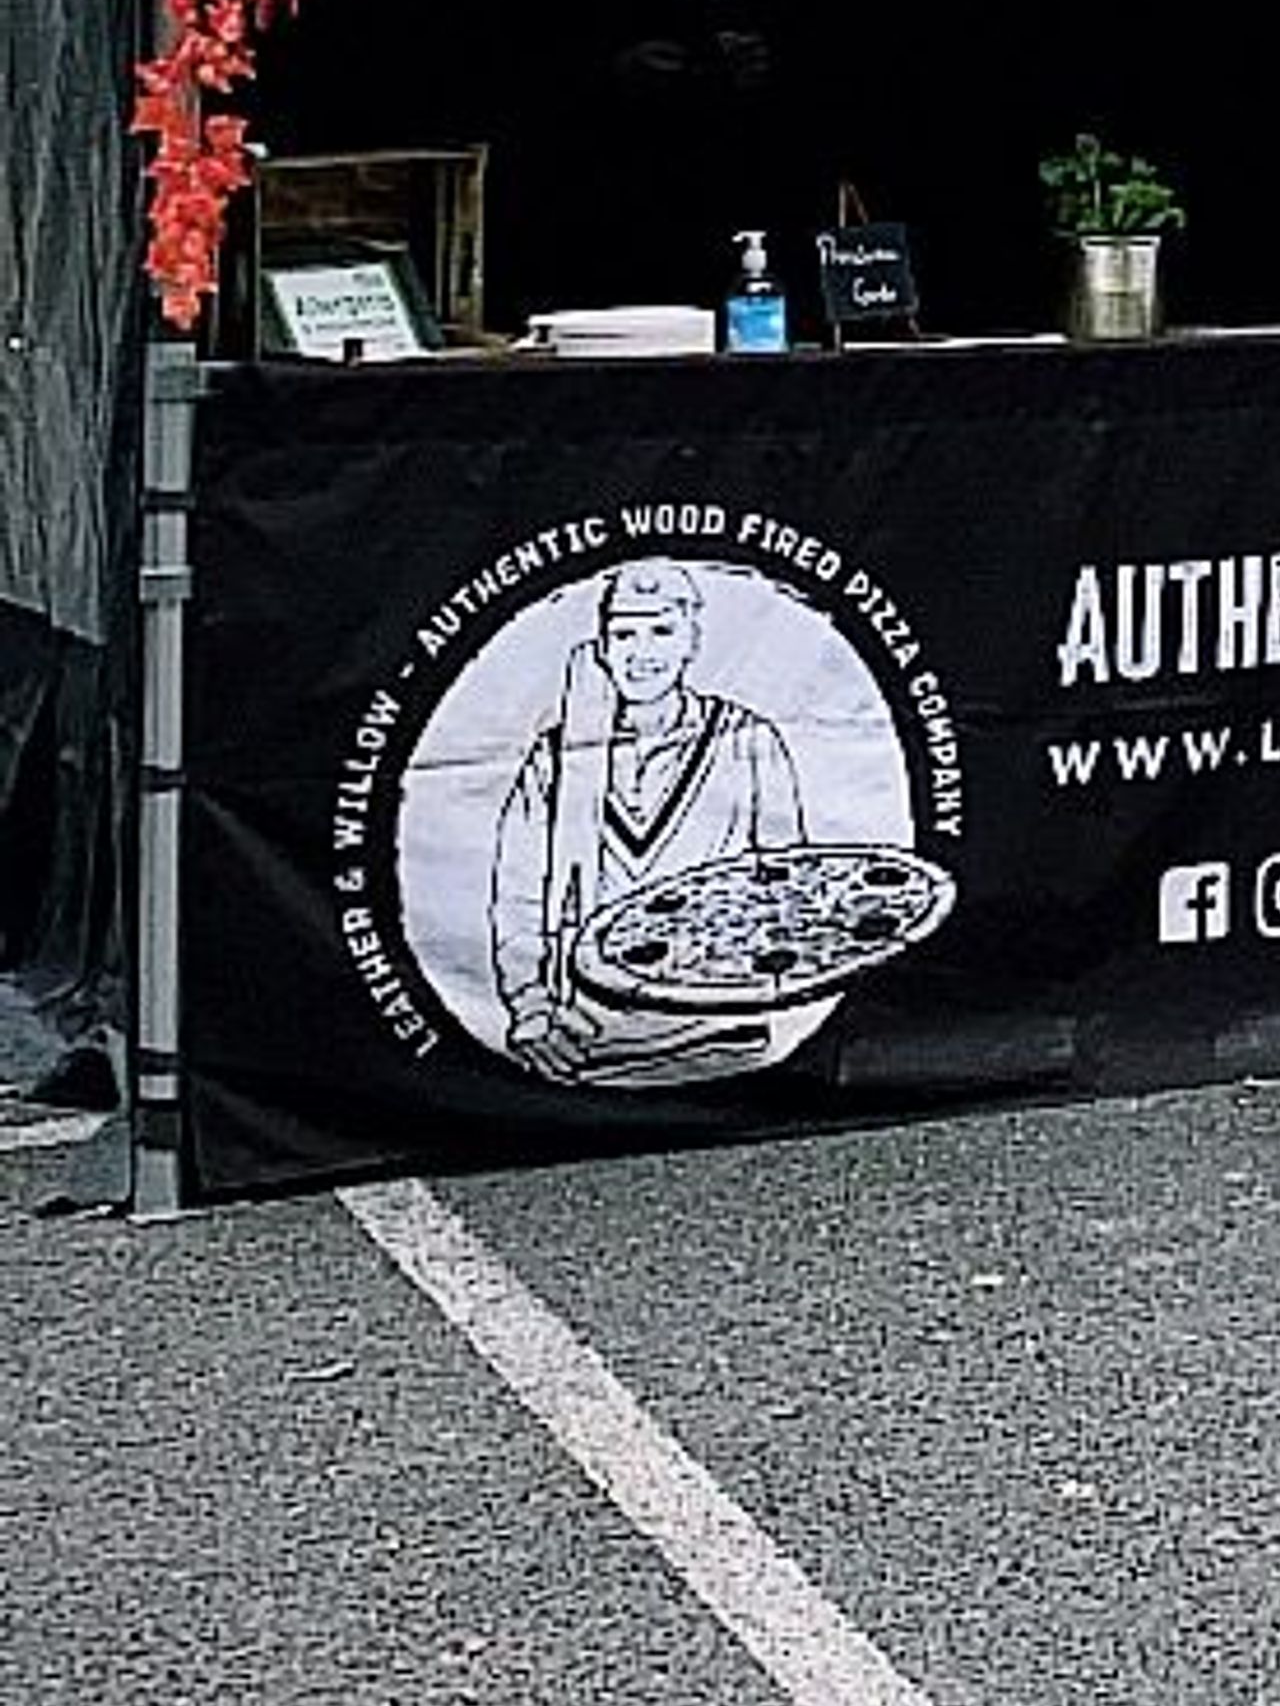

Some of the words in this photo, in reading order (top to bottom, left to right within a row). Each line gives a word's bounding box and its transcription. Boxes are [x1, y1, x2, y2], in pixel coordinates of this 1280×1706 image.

[620, 503, 726, 536] WOOD
[737, 512, 841, 580] FIRED
[415, 517, 608, 657] AUTHENTIC
[843, 568, 920, 668] PIZZA
[333, 688, 403, 851] WILLOW
[907, 671, 964, 839] COMPANY
[333, 867, 365, 893] &
[339, 908, 440, 1059] LEATHER
